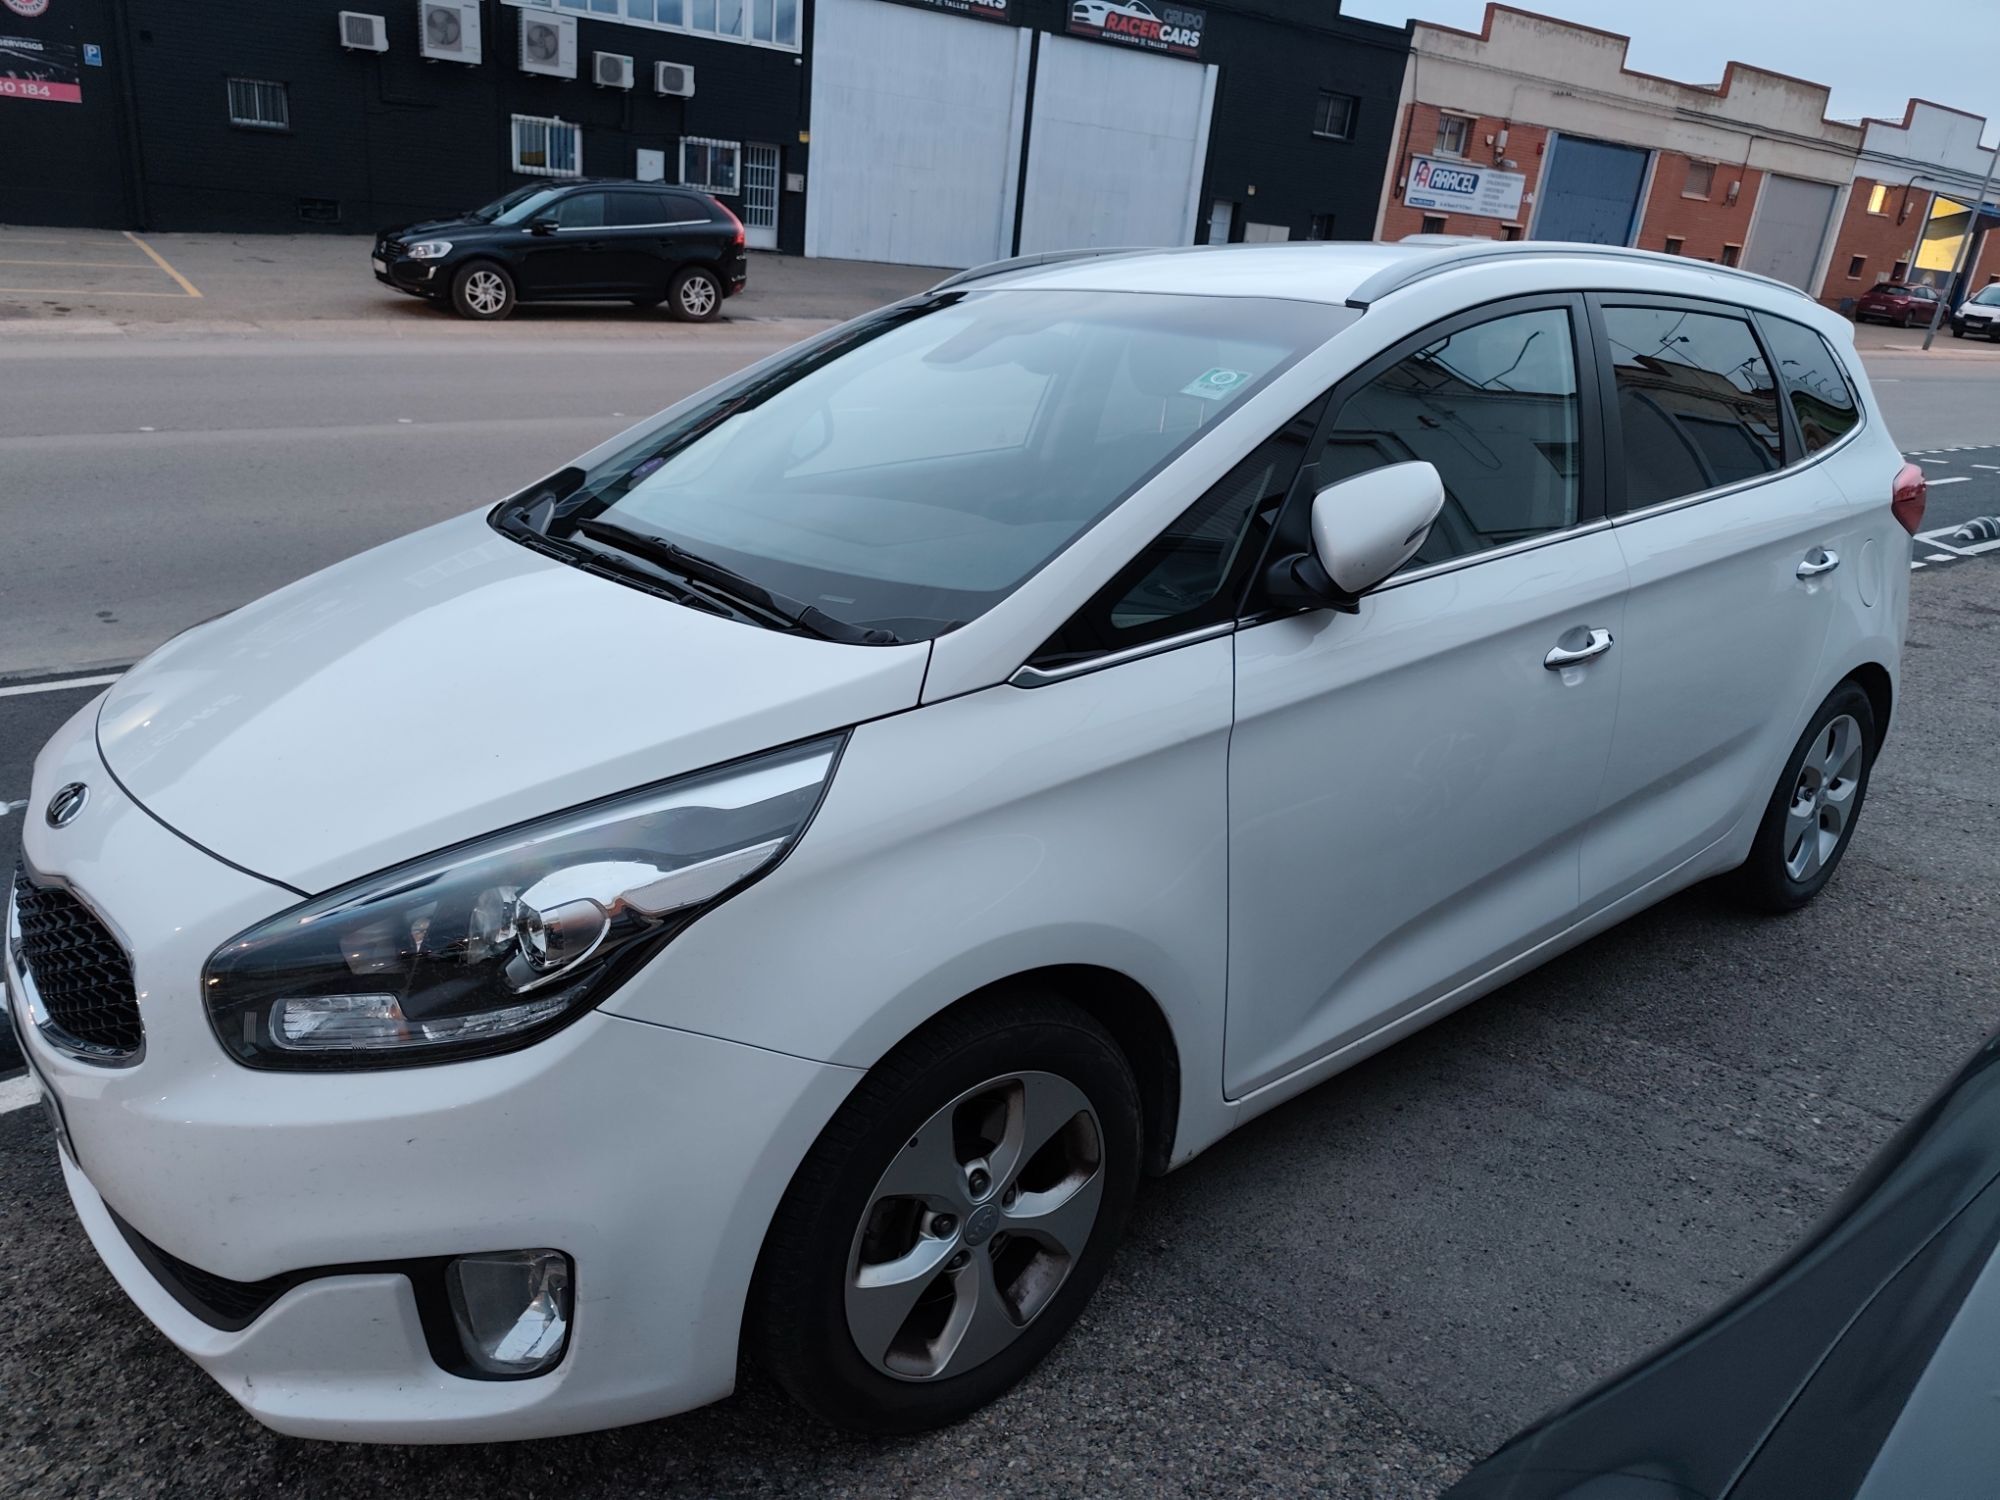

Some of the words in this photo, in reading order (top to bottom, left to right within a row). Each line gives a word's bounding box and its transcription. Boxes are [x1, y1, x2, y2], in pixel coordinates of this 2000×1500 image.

[1163, 9, 1202, 30] GRUPO
[20, 84, 50, 96] 184
[1431, 168, 1475, 193] ARACEL
